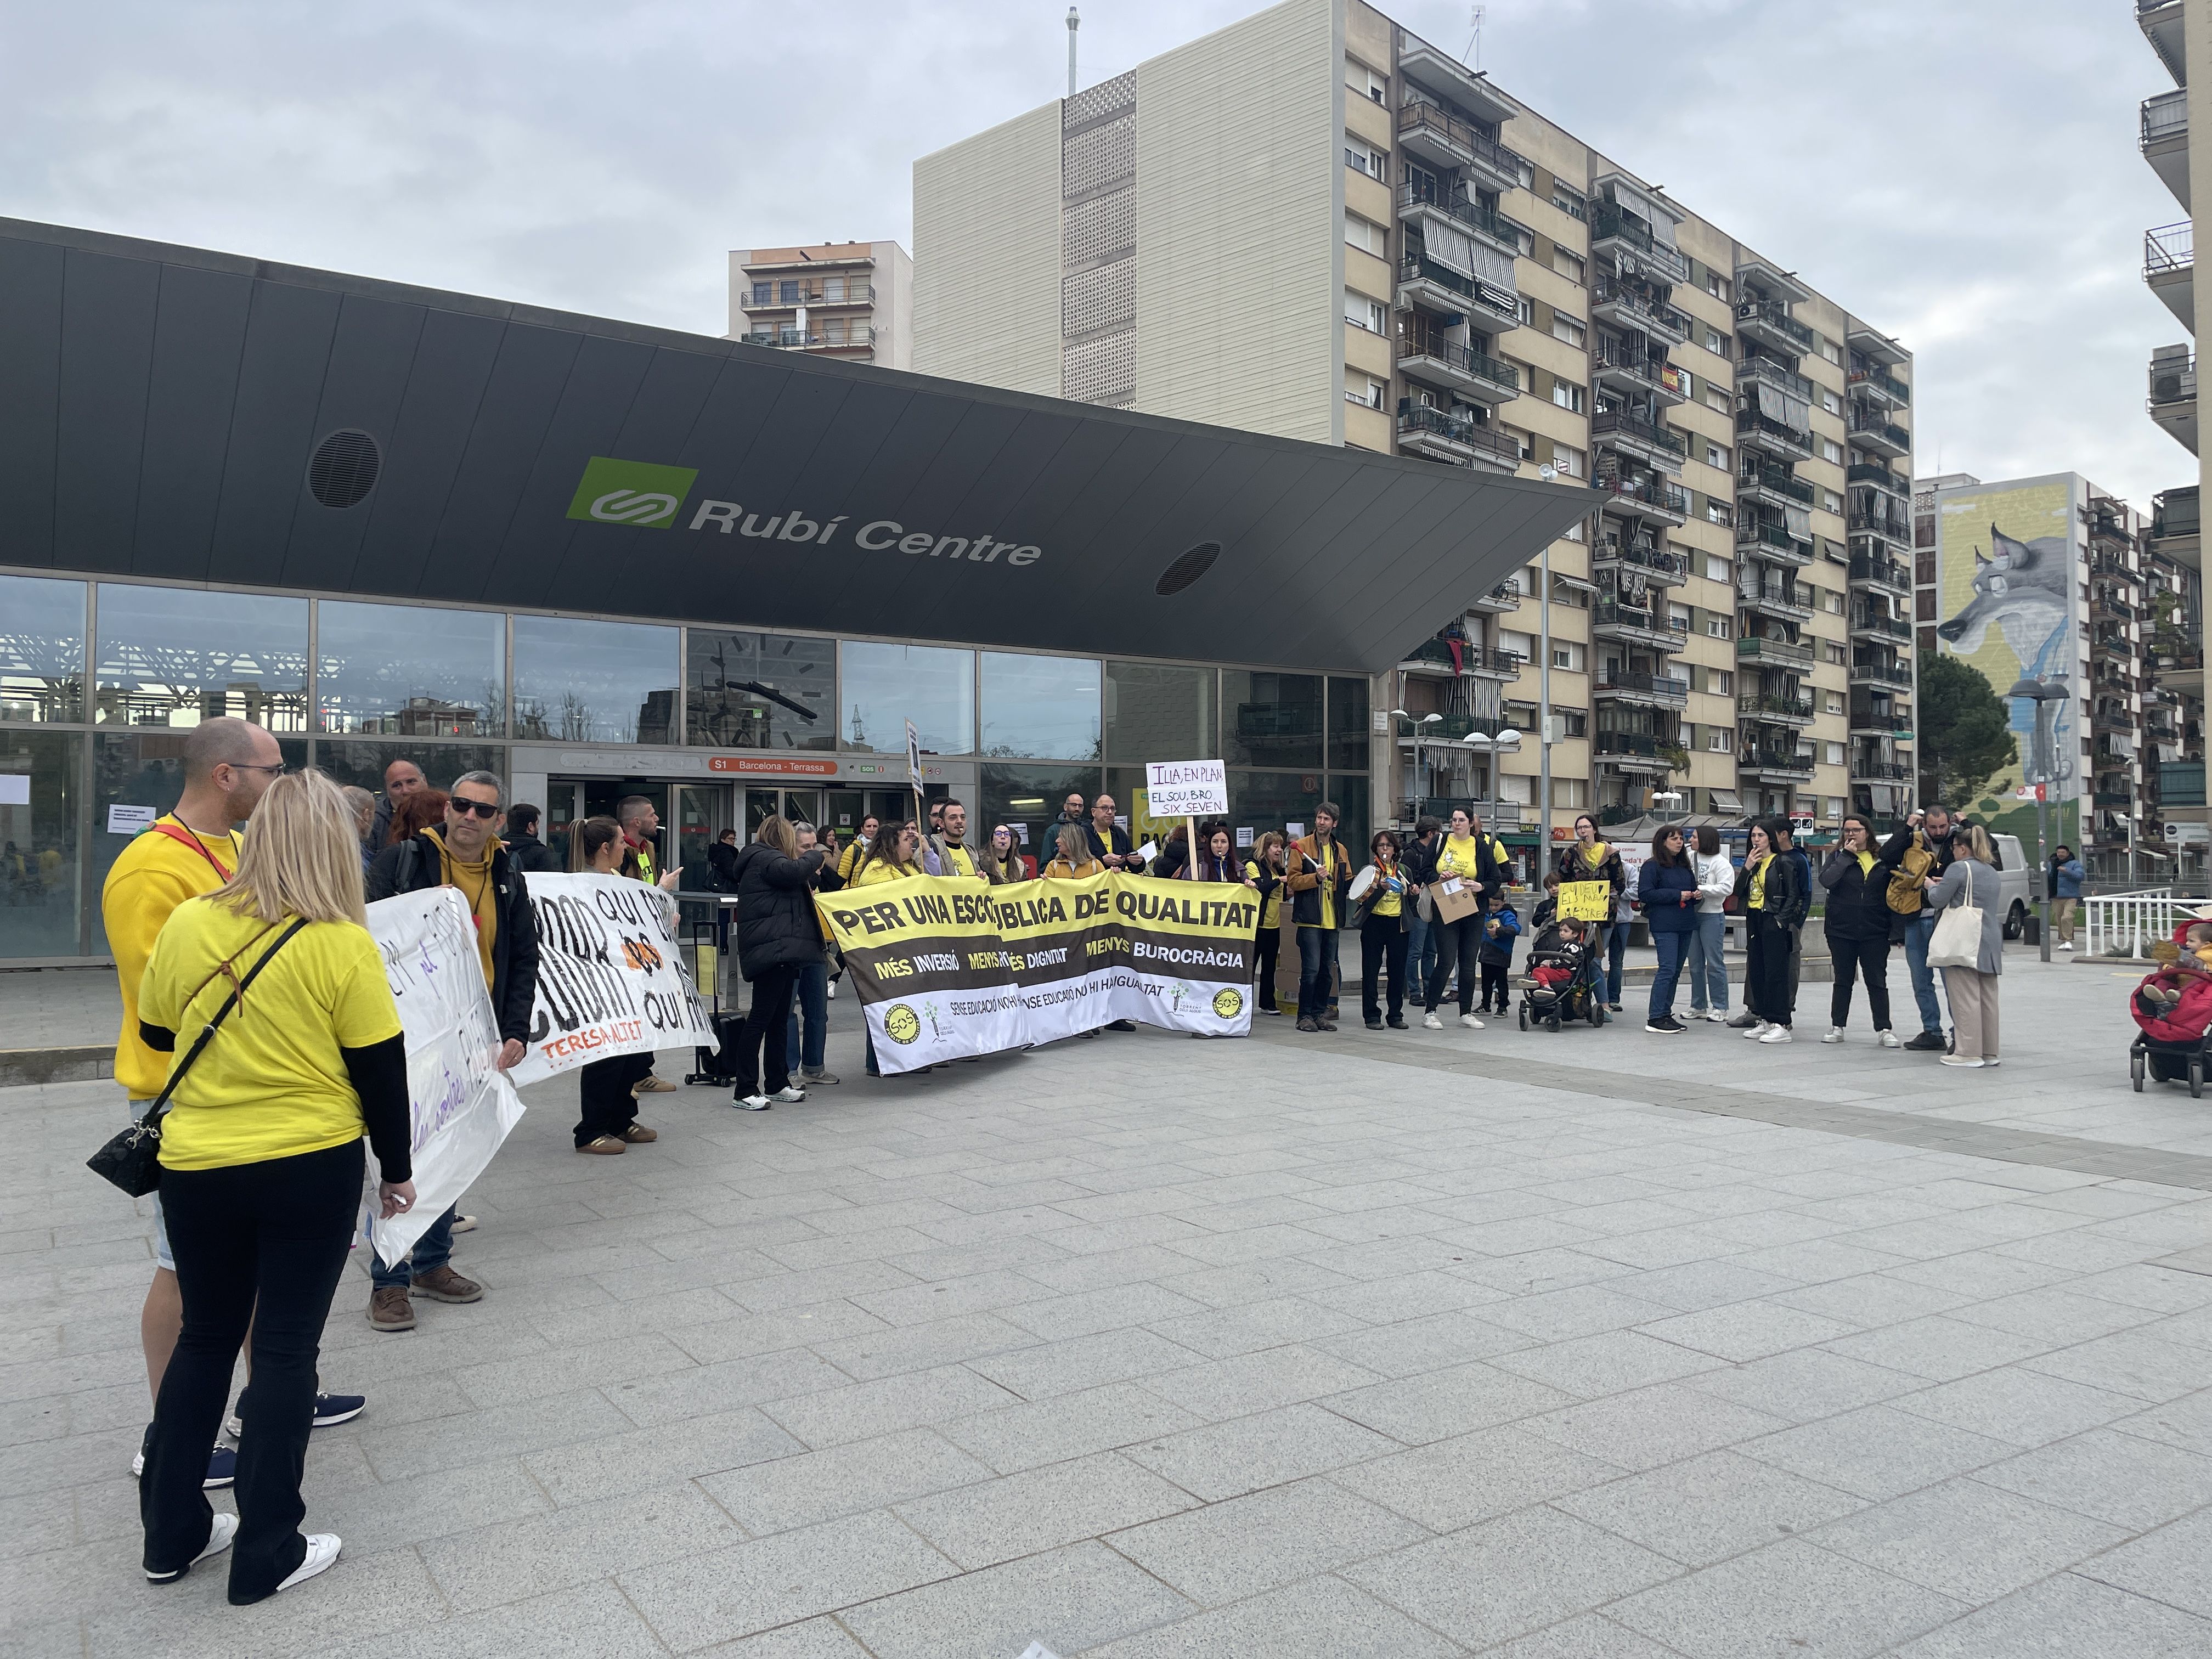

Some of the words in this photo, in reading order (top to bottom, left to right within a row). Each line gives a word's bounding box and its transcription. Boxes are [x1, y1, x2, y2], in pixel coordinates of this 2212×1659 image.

[689, 499, 849, 544] Rubí
[854, 520, 1042, 567] Centre
[715, 760, 726, 769] S1
[739, 761, 782, 770] Barcelona
[789, 763, 825, 772] Terrassa
[1184, 767, 1198, 782] EN
[1201, 767, 1223, 782] PLAN,
[1152, 793, 1165, 803] EL
[1166, 792, 1188, 802] SOU,
[1161, 804, 1181, 814] SIX
[1184, 801, 1223, 813] SEVEN
[595, 888, 647, 927] QUI
[831, 901, 907, 936] PER
[902, 894, 952, 926] UNA
[1074, 888, 1110, 920] DE
[1115, 890, 1257, 929] QUALITAT
[874, 957, 913, 980] MÉS
[912, 949, 960, 973] INVERSIÓ
[967, 951, 1000, 970] MENYS
[1009, 951, 1025, 972] ÉS
[1027, 947, 1068, 969] DIGNITAT
[1086, 936, 1130, 957] MENYS
[1133, 941, 1244, 968] BUROCRÀCIA
[950, 1002, 968, 1015] SENSE
[967, 995, 997, 1015] EDUCACIÓ
[1089, 980, 1098, 994] HI
[1113, 975, 1165, 997] IGUALTAT
[1217, 997, 1239, 1009] SOS
[644, 990, 685, 1034] QUI
[891, 1012, 914, 1034] SOS
